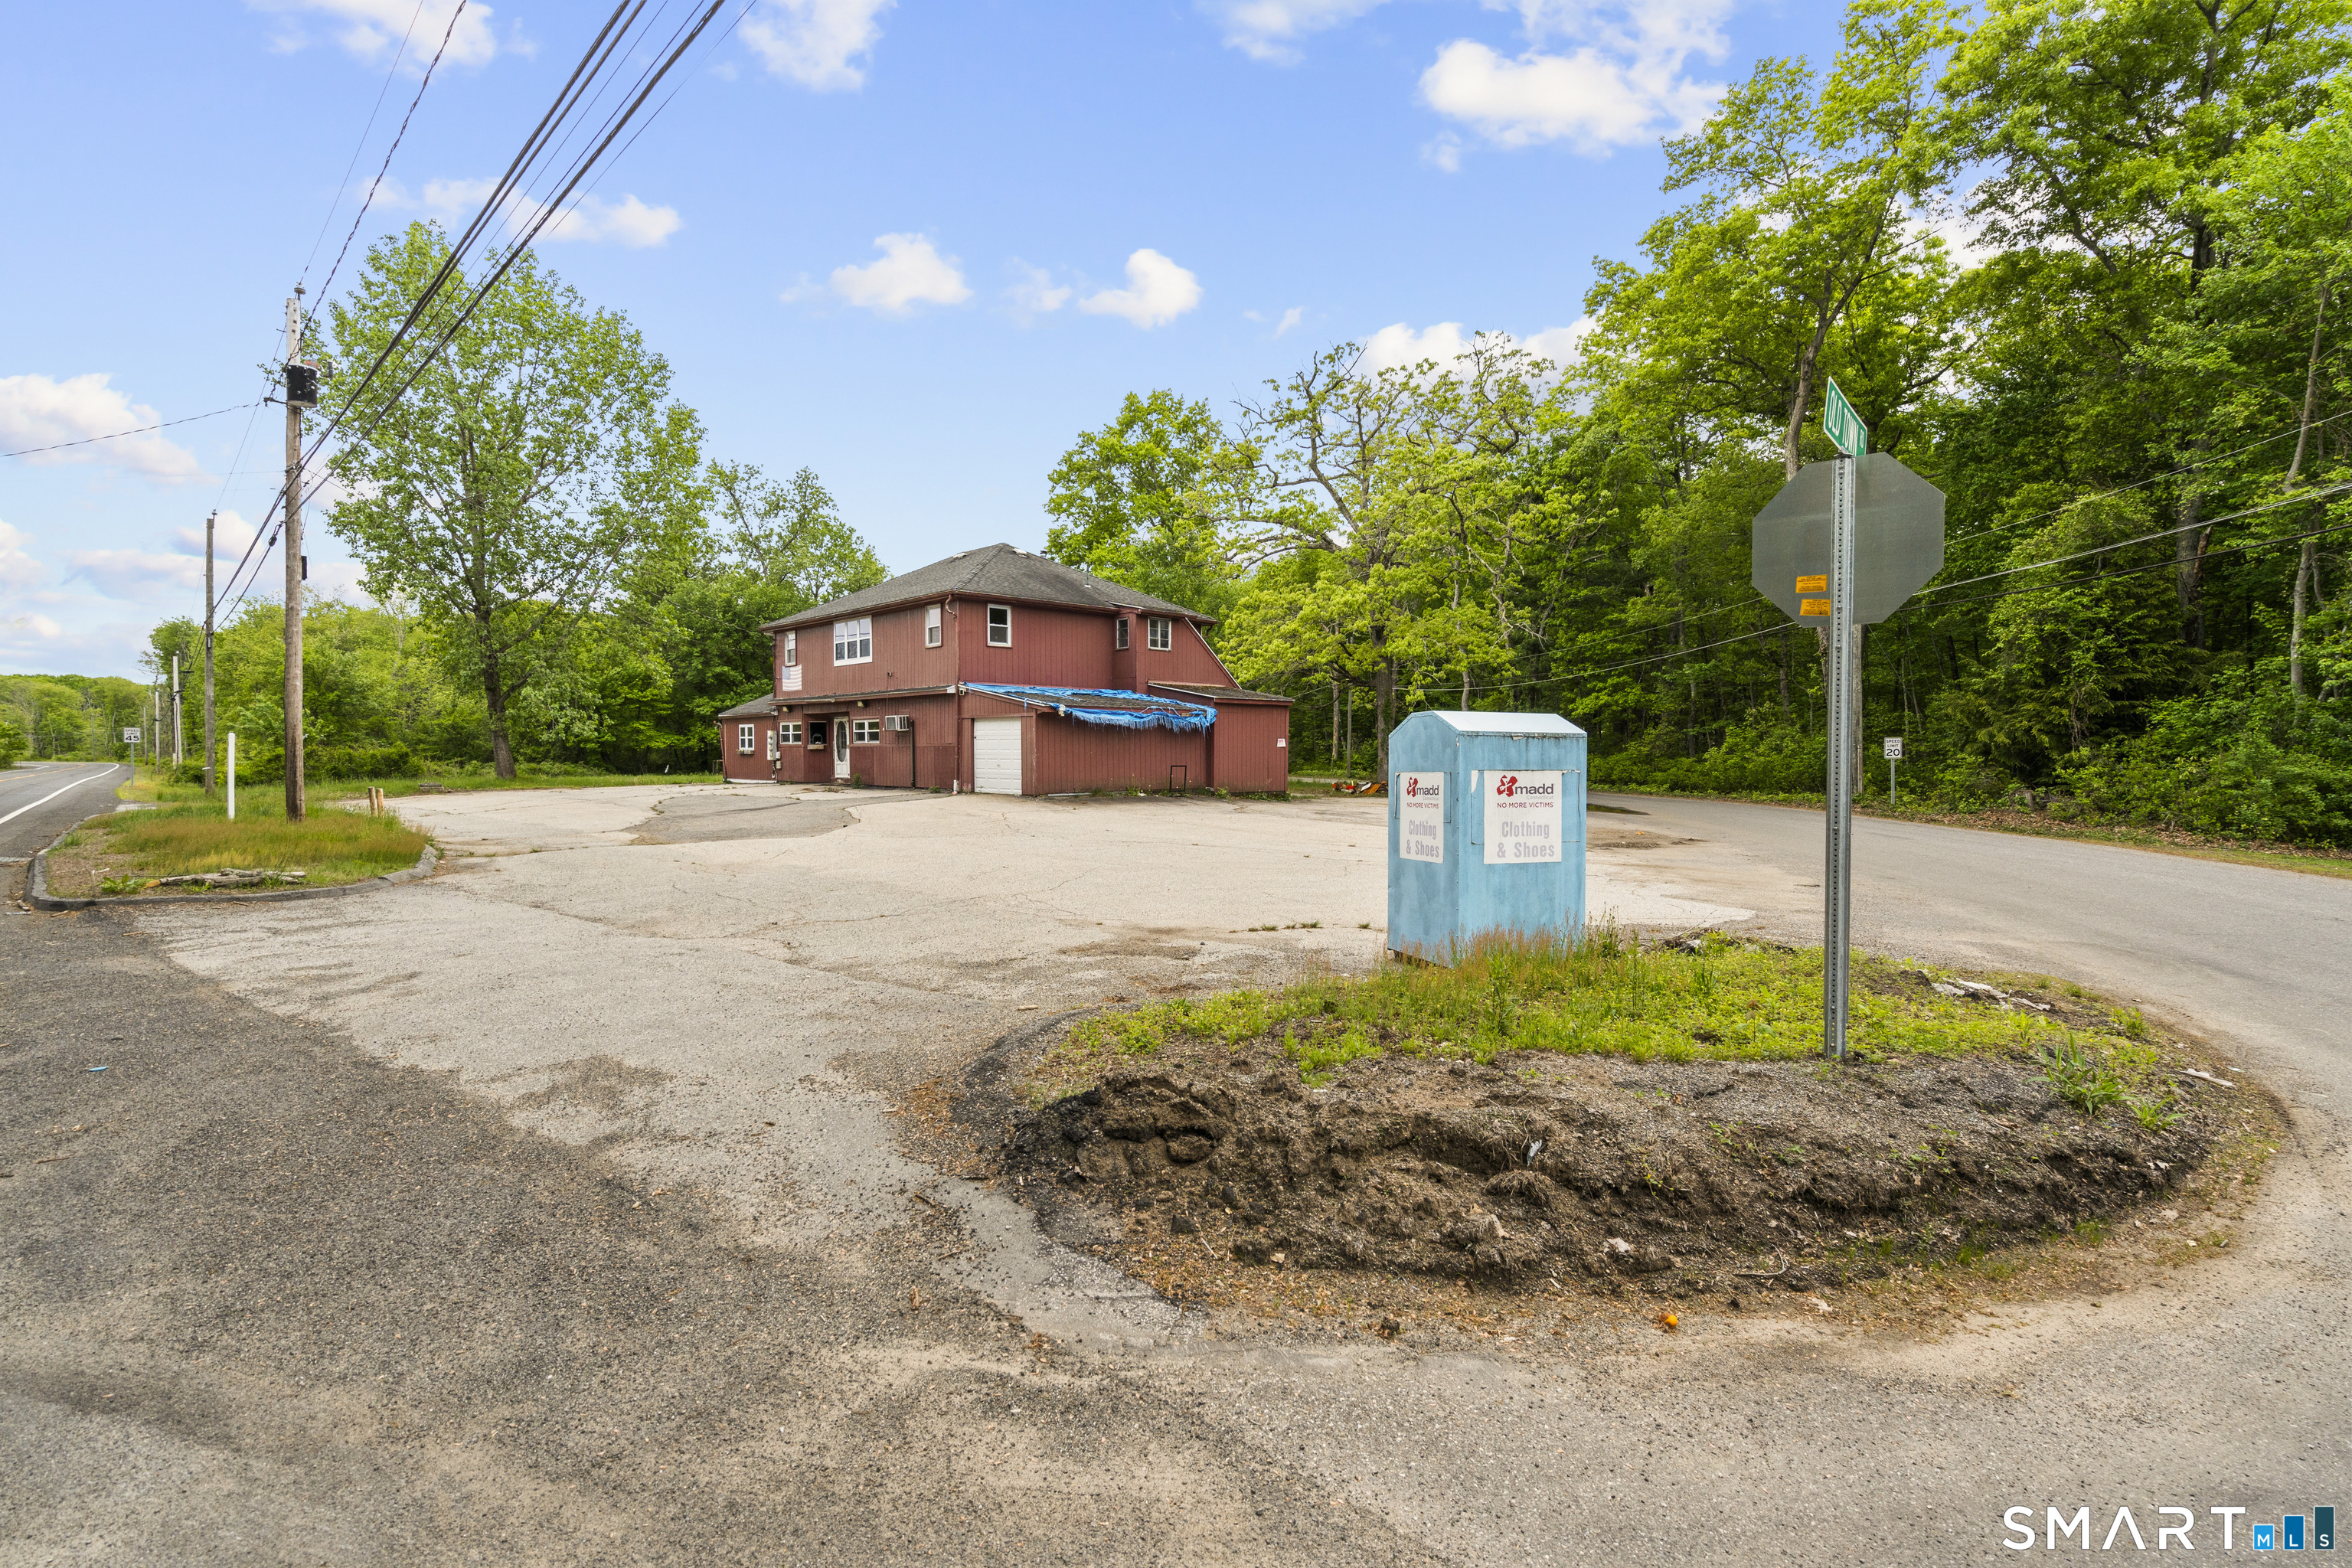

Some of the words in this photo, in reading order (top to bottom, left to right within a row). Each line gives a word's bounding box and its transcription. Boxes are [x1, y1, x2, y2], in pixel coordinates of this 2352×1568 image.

[1828, 390, 1842, 437] OLD
[1842, 407, 1859, 457] TOWN
[1416, 785, 1439, 795] madd
[1514, 783, 1554, 795] madd
[1409, 819, 1436, 840] Clothing
[1501, 821, 1550, 839] Clothing
[1406, 839, 1412, 854] &
[1415, 840, 1439, 858] Shoes
[1497, 842, 1506, 858] &
[1514, 842, 1555, 858] Shoes
